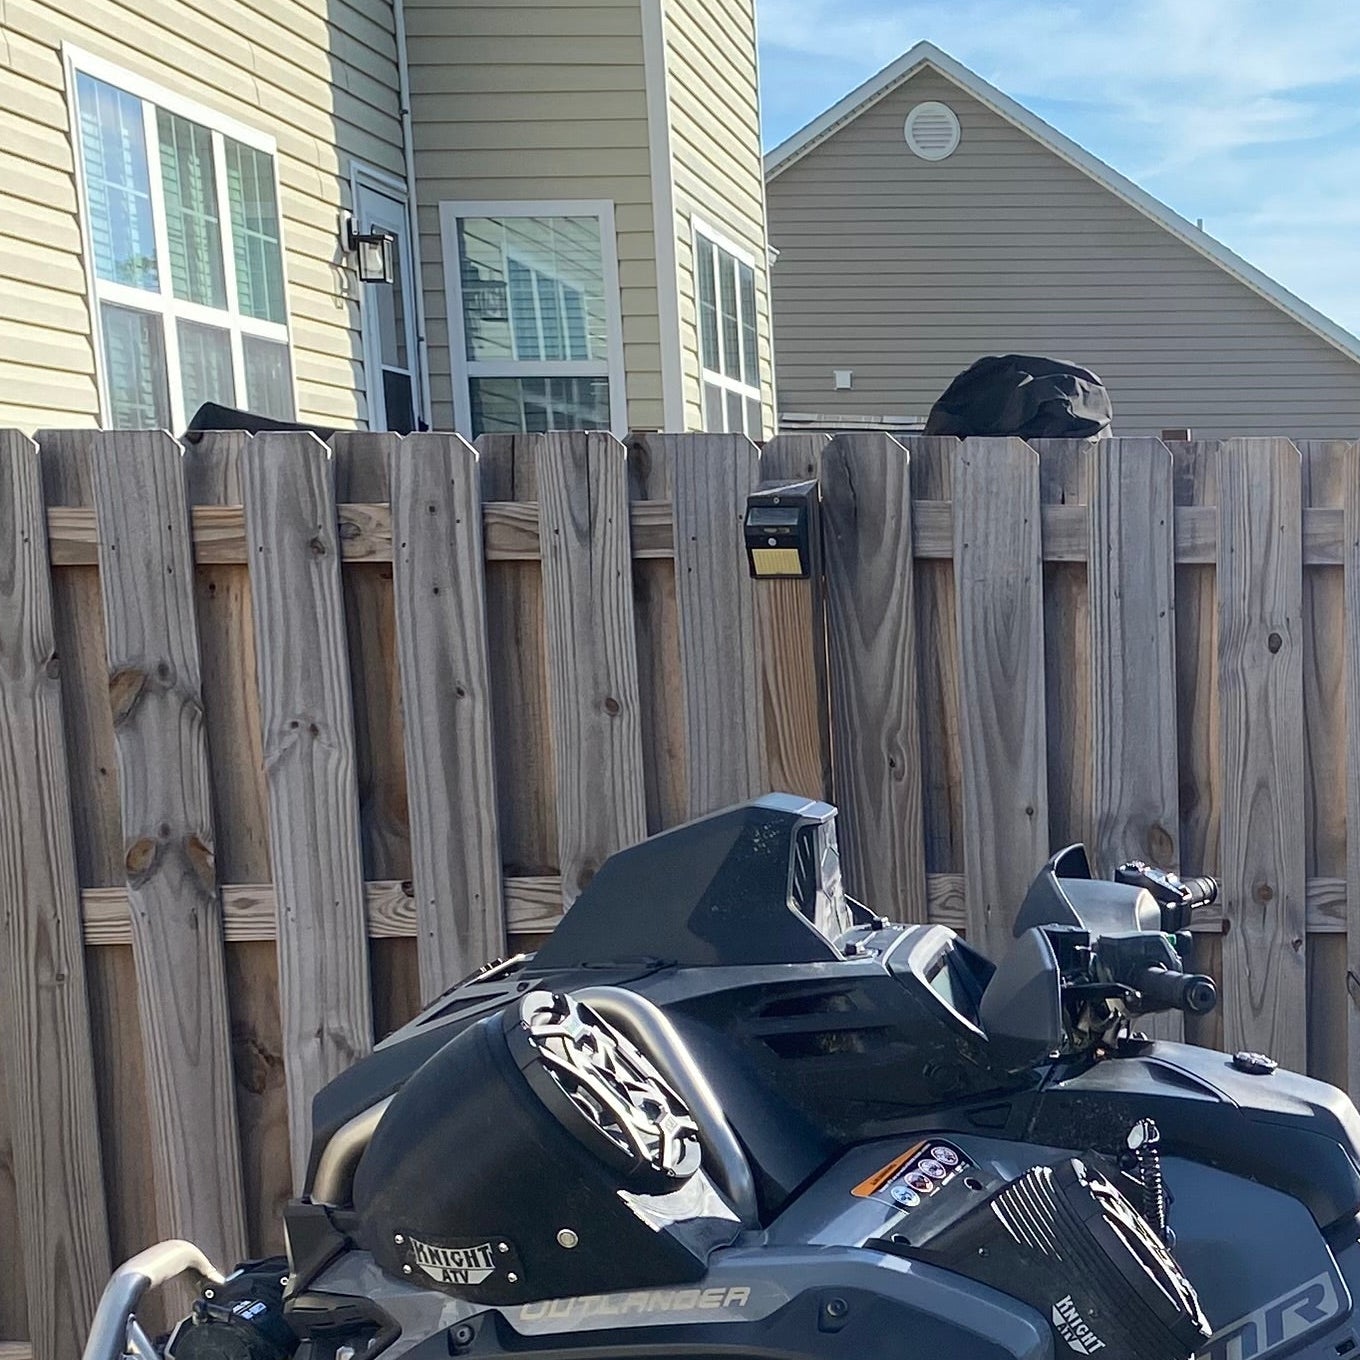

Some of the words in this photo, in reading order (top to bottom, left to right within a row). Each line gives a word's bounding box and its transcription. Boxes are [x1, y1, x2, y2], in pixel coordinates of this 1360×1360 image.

[412, 1240, 495, 1268] KNIGHT
[441, 1268, 469, 1283] ATV
[519, 1286, 751, 1321] OUTLANDER
[1055, 1294, 1107, 1353] KNIGHT
[1056, 1322, 1079, 1343] ATV
